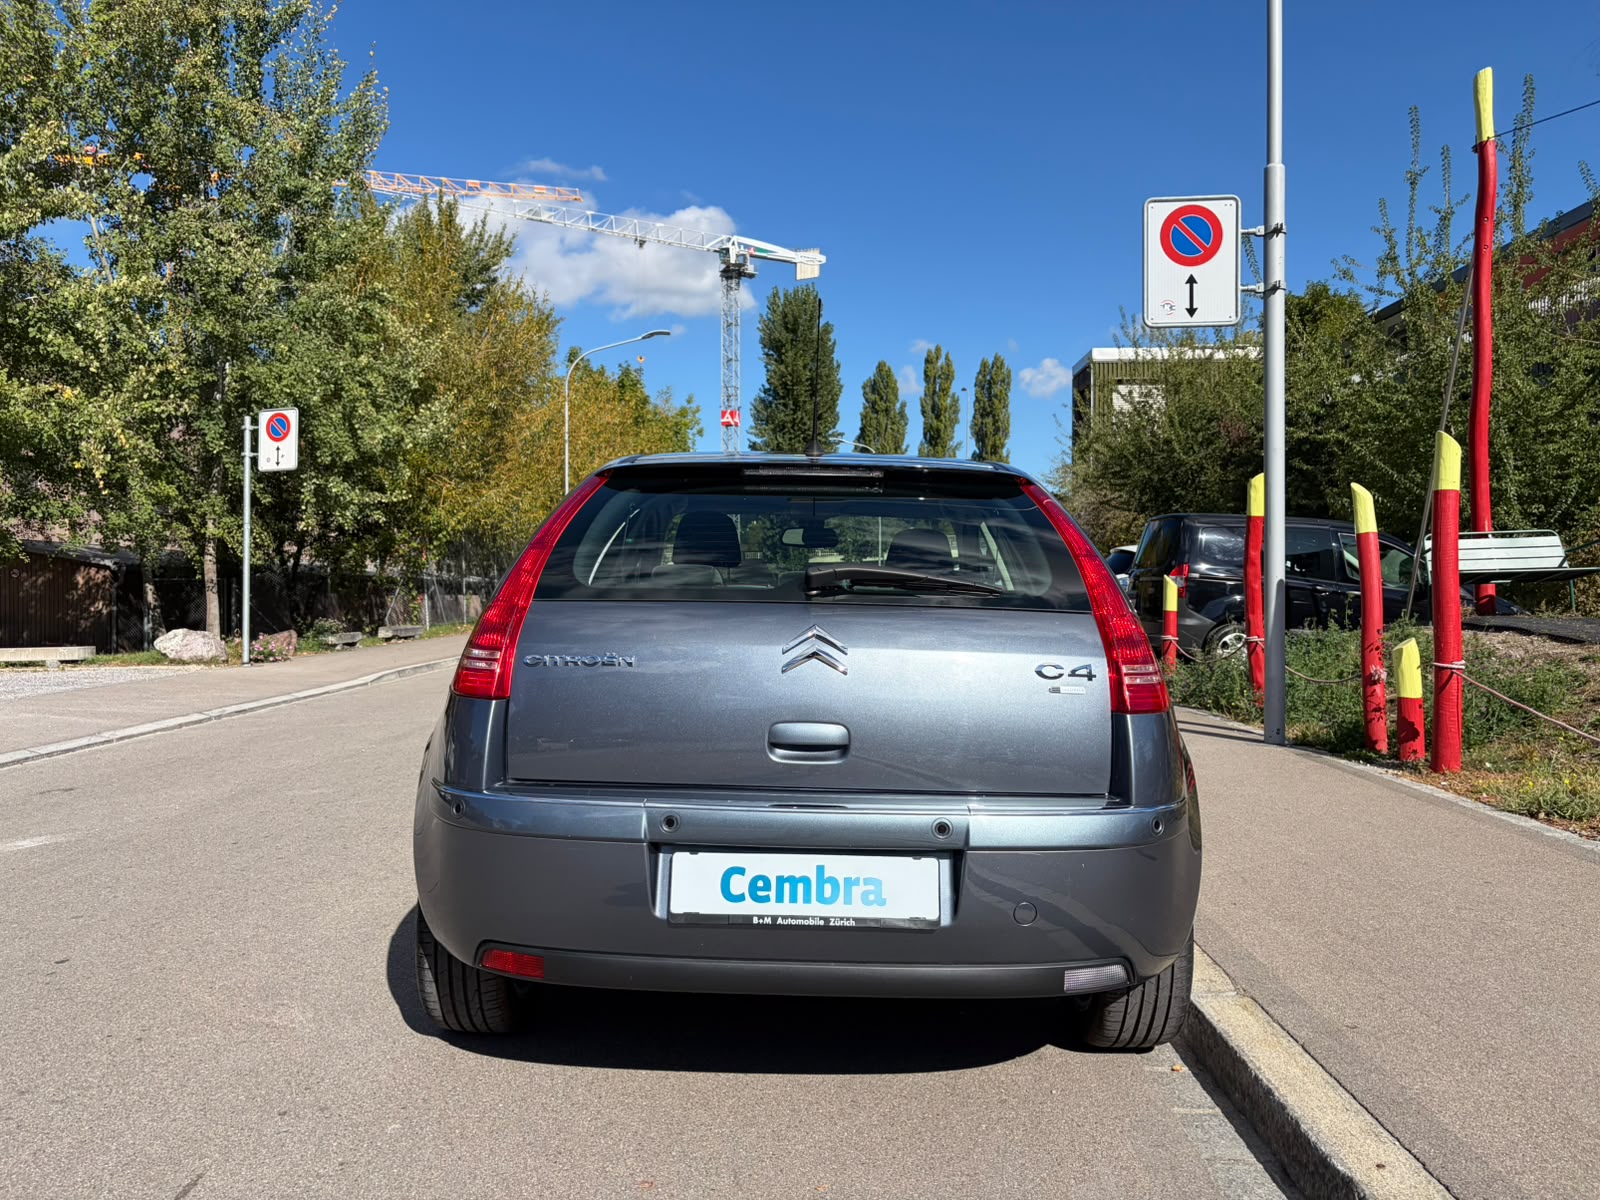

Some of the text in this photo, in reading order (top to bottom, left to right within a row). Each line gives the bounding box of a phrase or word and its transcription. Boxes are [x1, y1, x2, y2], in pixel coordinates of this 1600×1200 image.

[522, 652, 636, 668] CITROËN
[1034, 663, 1097, 682] C4
[720, 864, 887, 907] Cembra
[752, 916, 856, 927] B+M Automobile Zürich
